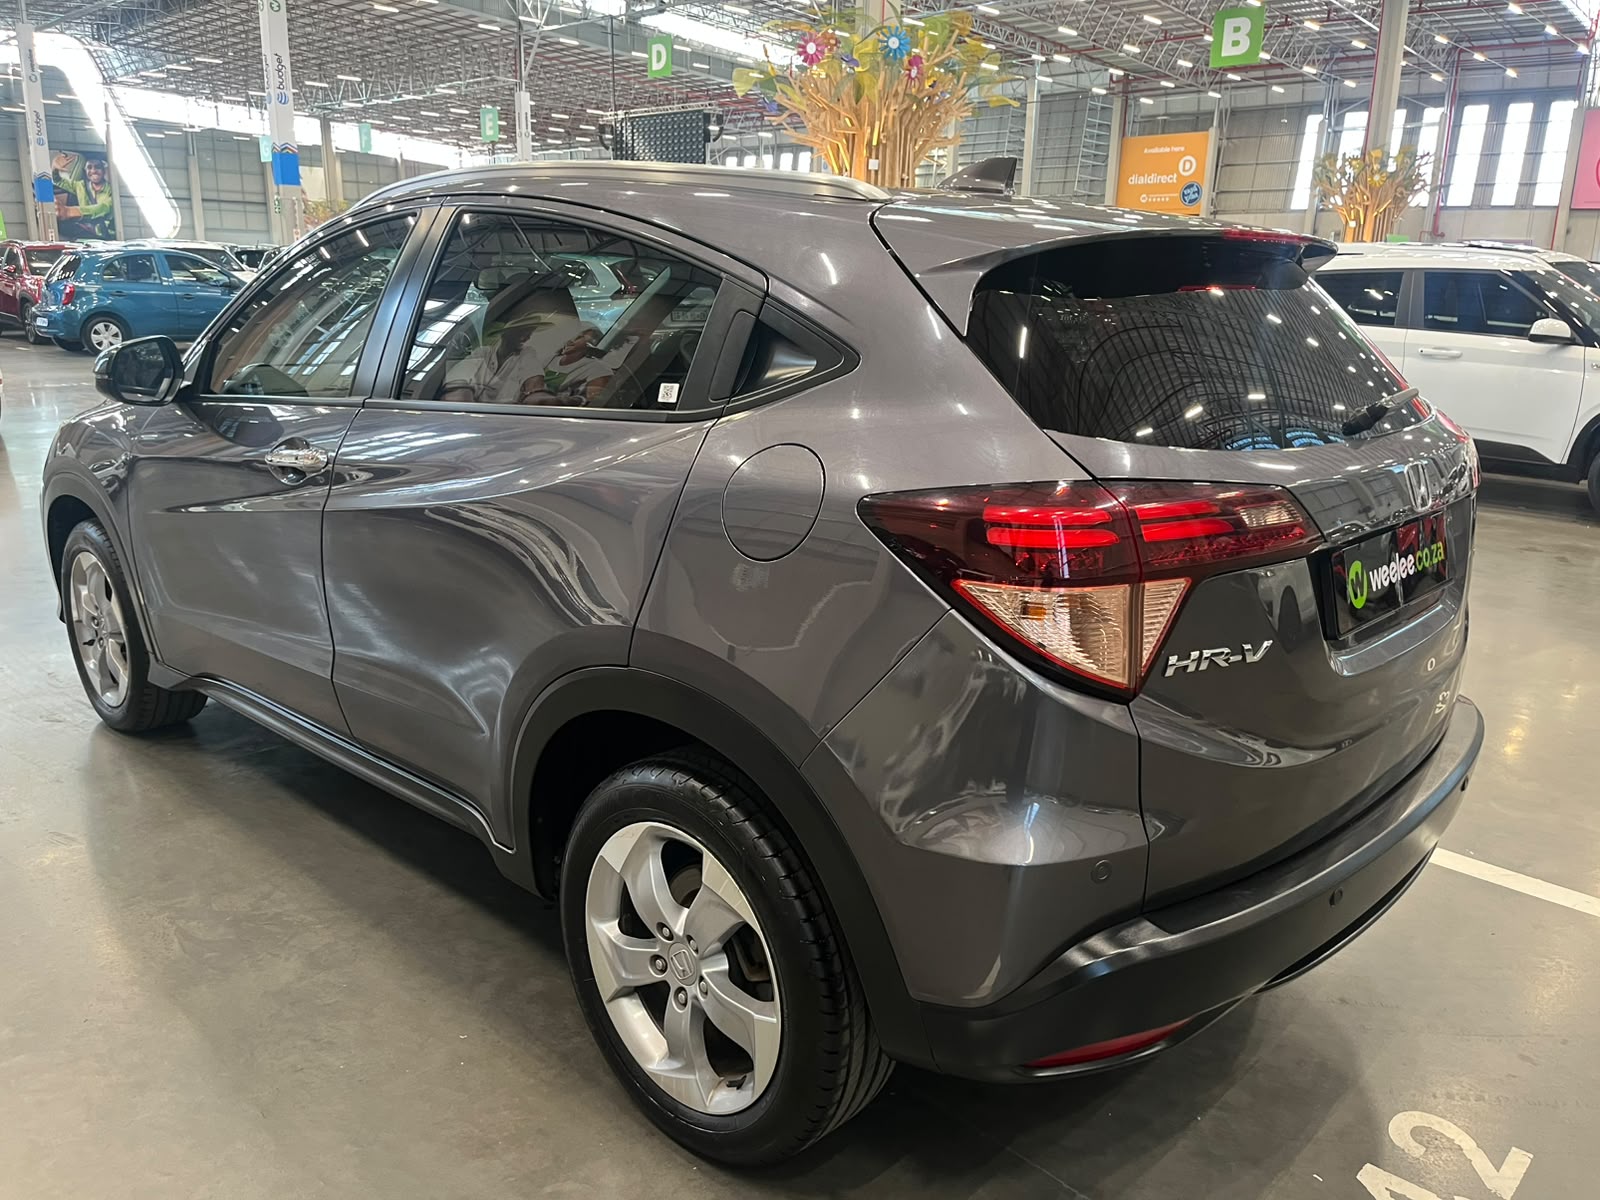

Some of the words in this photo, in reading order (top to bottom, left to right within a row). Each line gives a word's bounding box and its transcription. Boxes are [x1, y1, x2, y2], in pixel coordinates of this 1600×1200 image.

[1221, 16, 1252, 57] B
[273, 52, 287, 91] budget
[652, 43, 667, 71] D
[33, 110, 43, 137] budget
[485, 113, 494, 136] E
[1127, 173, 1178, 185] dialdirect
[1369, 541, 1445, 592] weelee.co.za
[1164, 639, 1274, 677] HR-V
